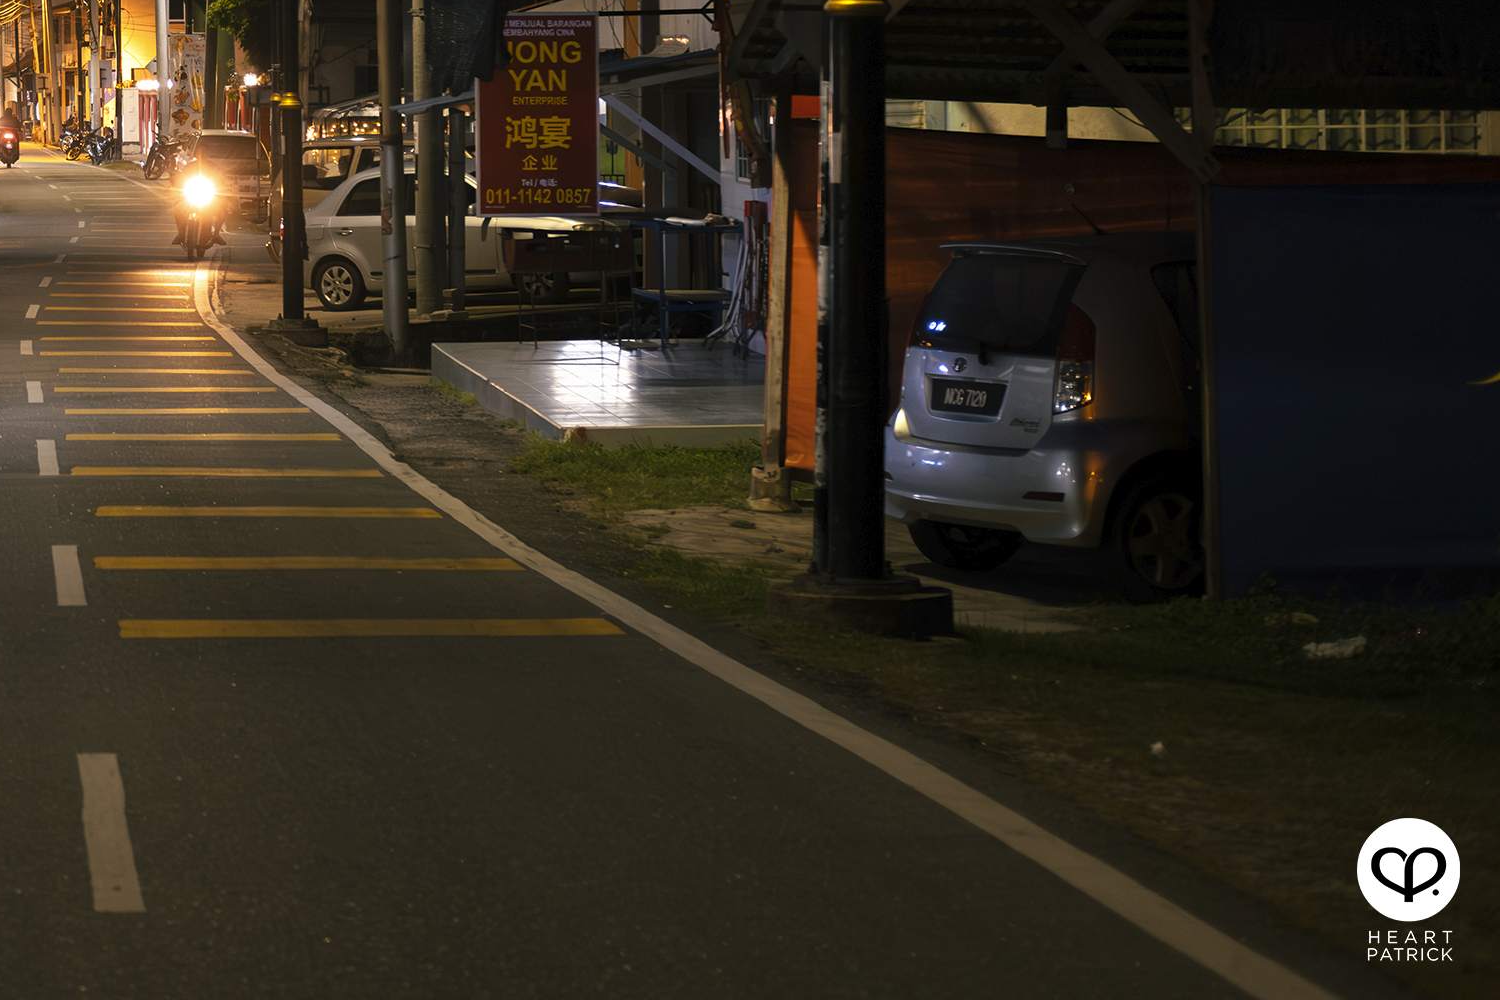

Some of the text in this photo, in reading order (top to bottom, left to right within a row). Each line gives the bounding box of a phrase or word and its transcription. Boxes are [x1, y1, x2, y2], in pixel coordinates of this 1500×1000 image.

[509, 20, 546, 28] MENJUAL
[547, 20, 592, 28] BARANGAN
[507, 69, 567, 92] YAN
[512, 96, 568, 106] ENTERPRISE
[505, 115, 572, 149] 鸿宴
[522, 154, 558, 171] 企业
[521, 179, 533, 187] Tel
[485, 188, 591, 204] 011-1142 0857
[965, 389, 988, 408] 7120
